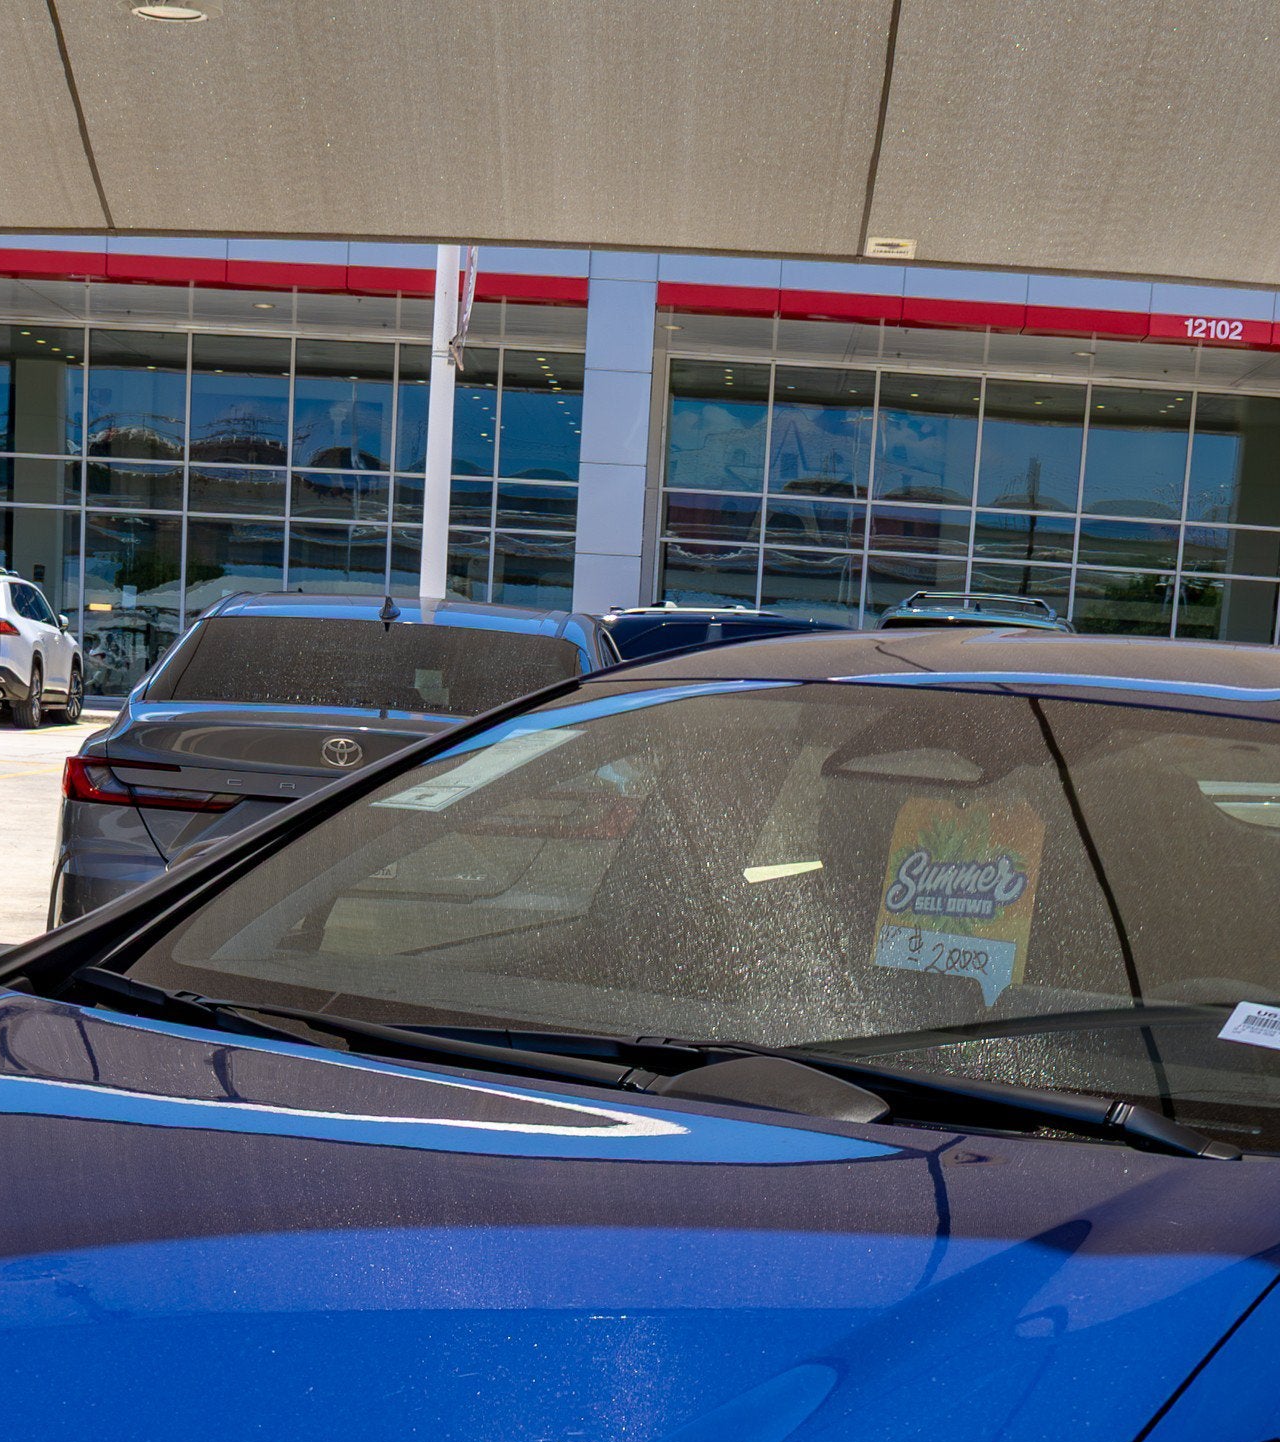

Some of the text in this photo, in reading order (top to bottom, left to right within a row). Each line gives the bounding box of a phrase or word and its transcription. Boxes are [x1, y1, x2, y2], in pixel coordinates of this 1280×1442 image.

[1184, 318, 1243, 340] 12102
[886, 851, 1023, 911] Summer
[914, 896, 993, 915] SELL DOWN
